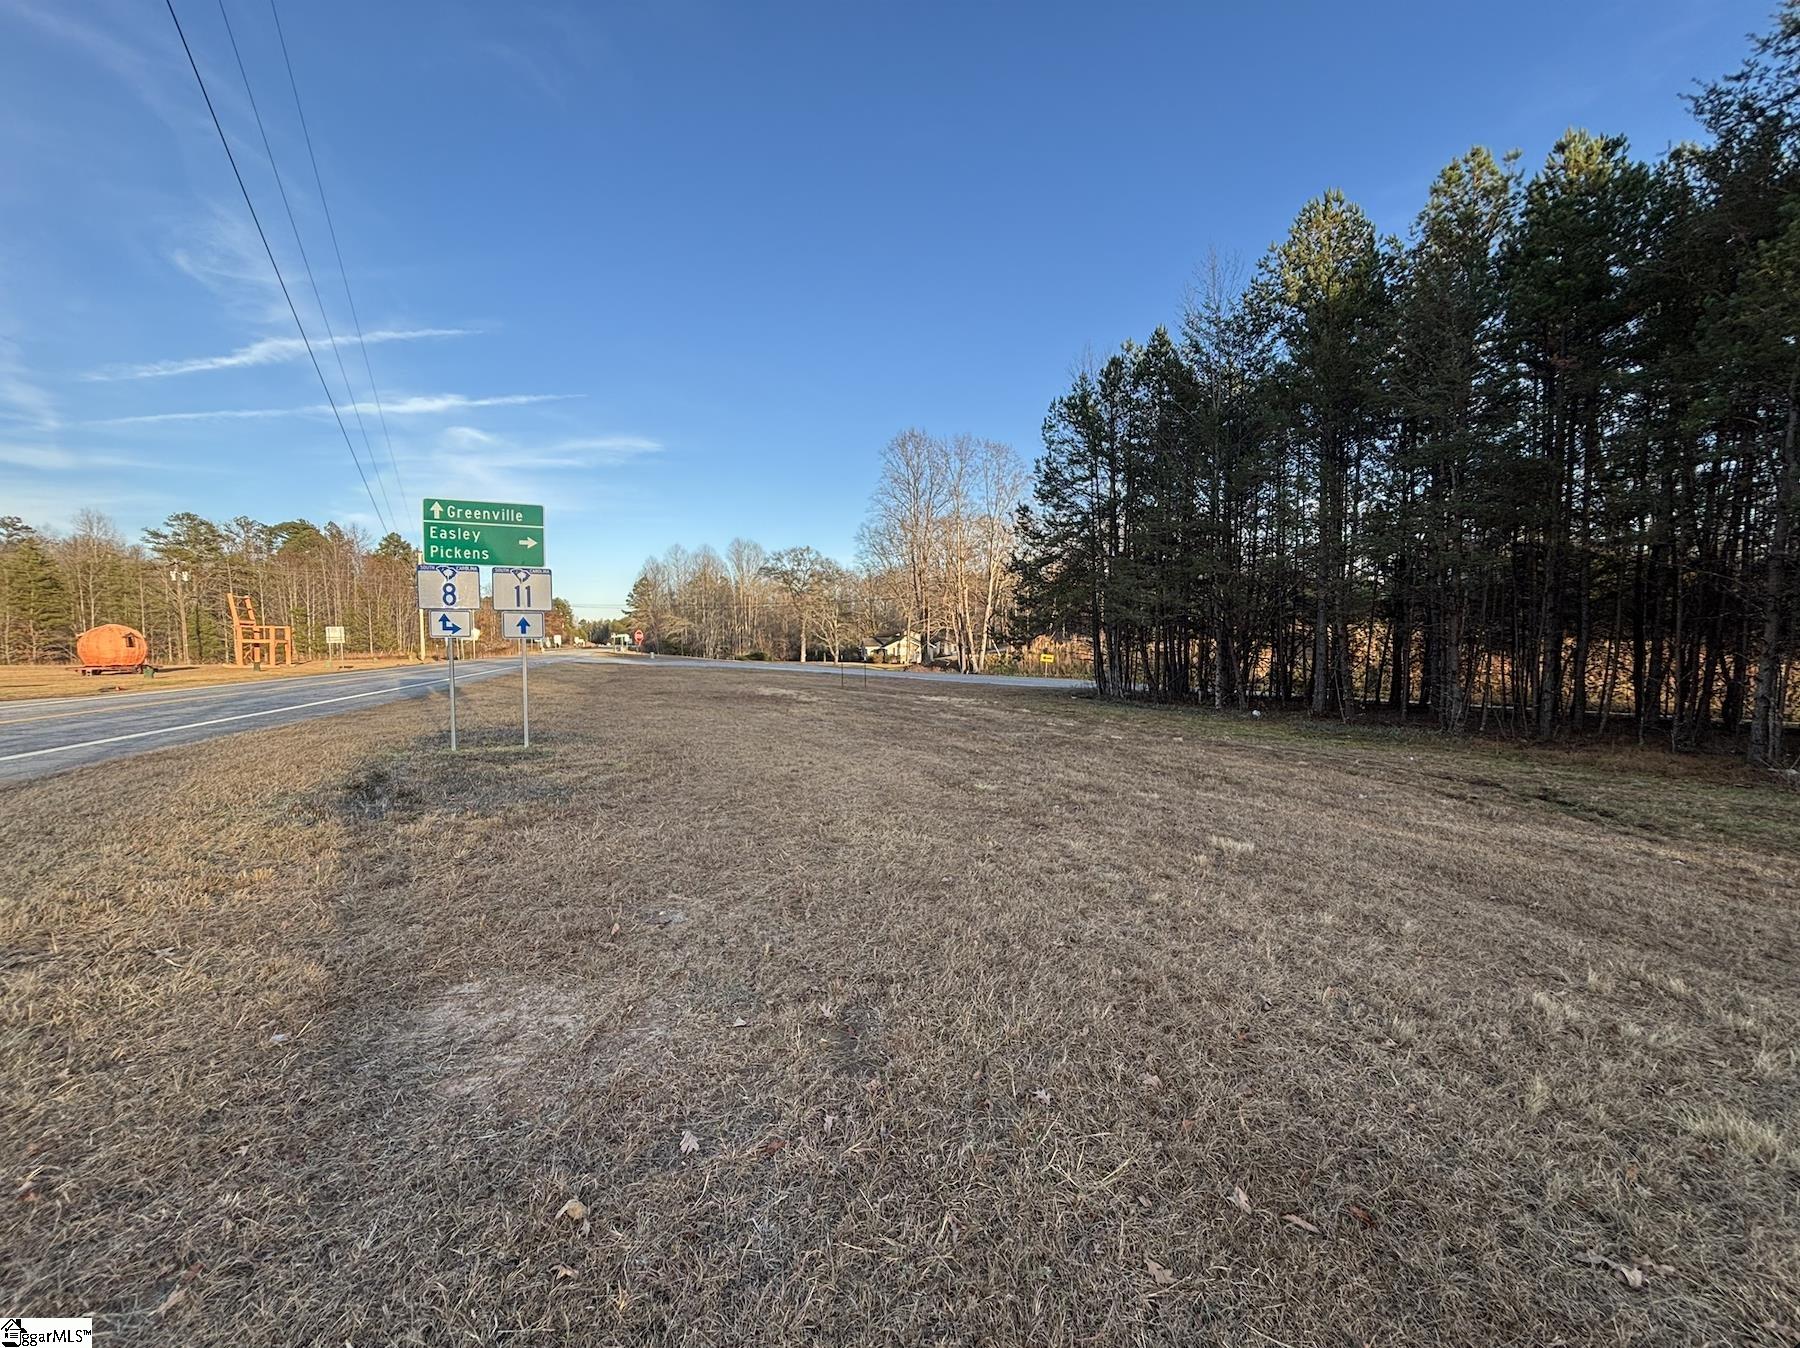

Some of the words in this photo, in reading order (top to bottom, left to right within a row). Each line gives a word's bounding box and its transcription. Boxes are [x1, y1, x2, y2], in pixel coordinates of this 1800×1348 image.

[447, 505, 523, 521] Greenville
[430, 526, 480, 543] Easley
[430, 545, 489, 560] Pickens
[442, 583, 457, 606] 8
[514, 585, 531, 608] 11
